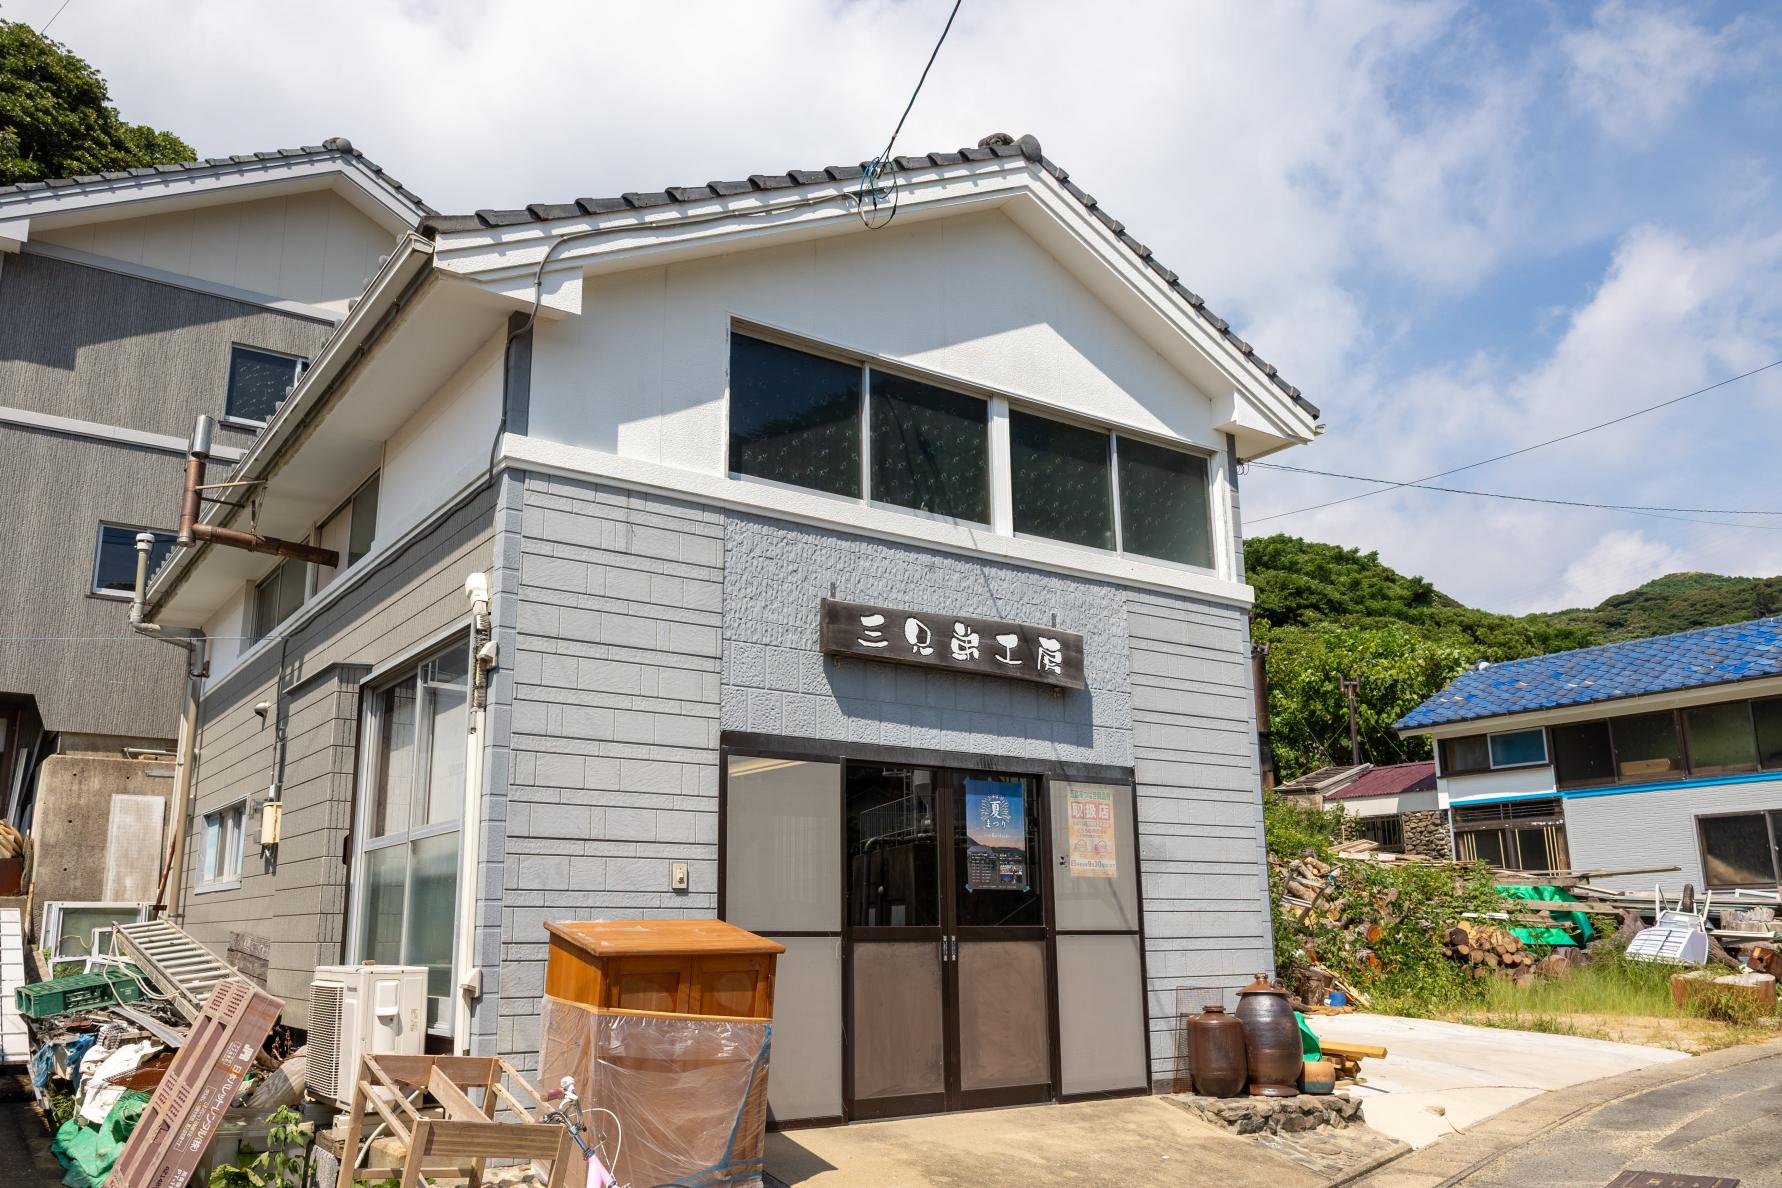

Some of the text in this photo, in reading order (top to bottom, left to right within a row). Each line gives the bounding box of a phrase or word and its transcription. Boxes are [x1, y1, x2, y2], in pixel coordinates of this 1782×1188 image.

[990, 800, 1003, 818] 夏
[1072, 802, 1110, 819] 取扱店
[985, 818, 1006, 829] まつり
